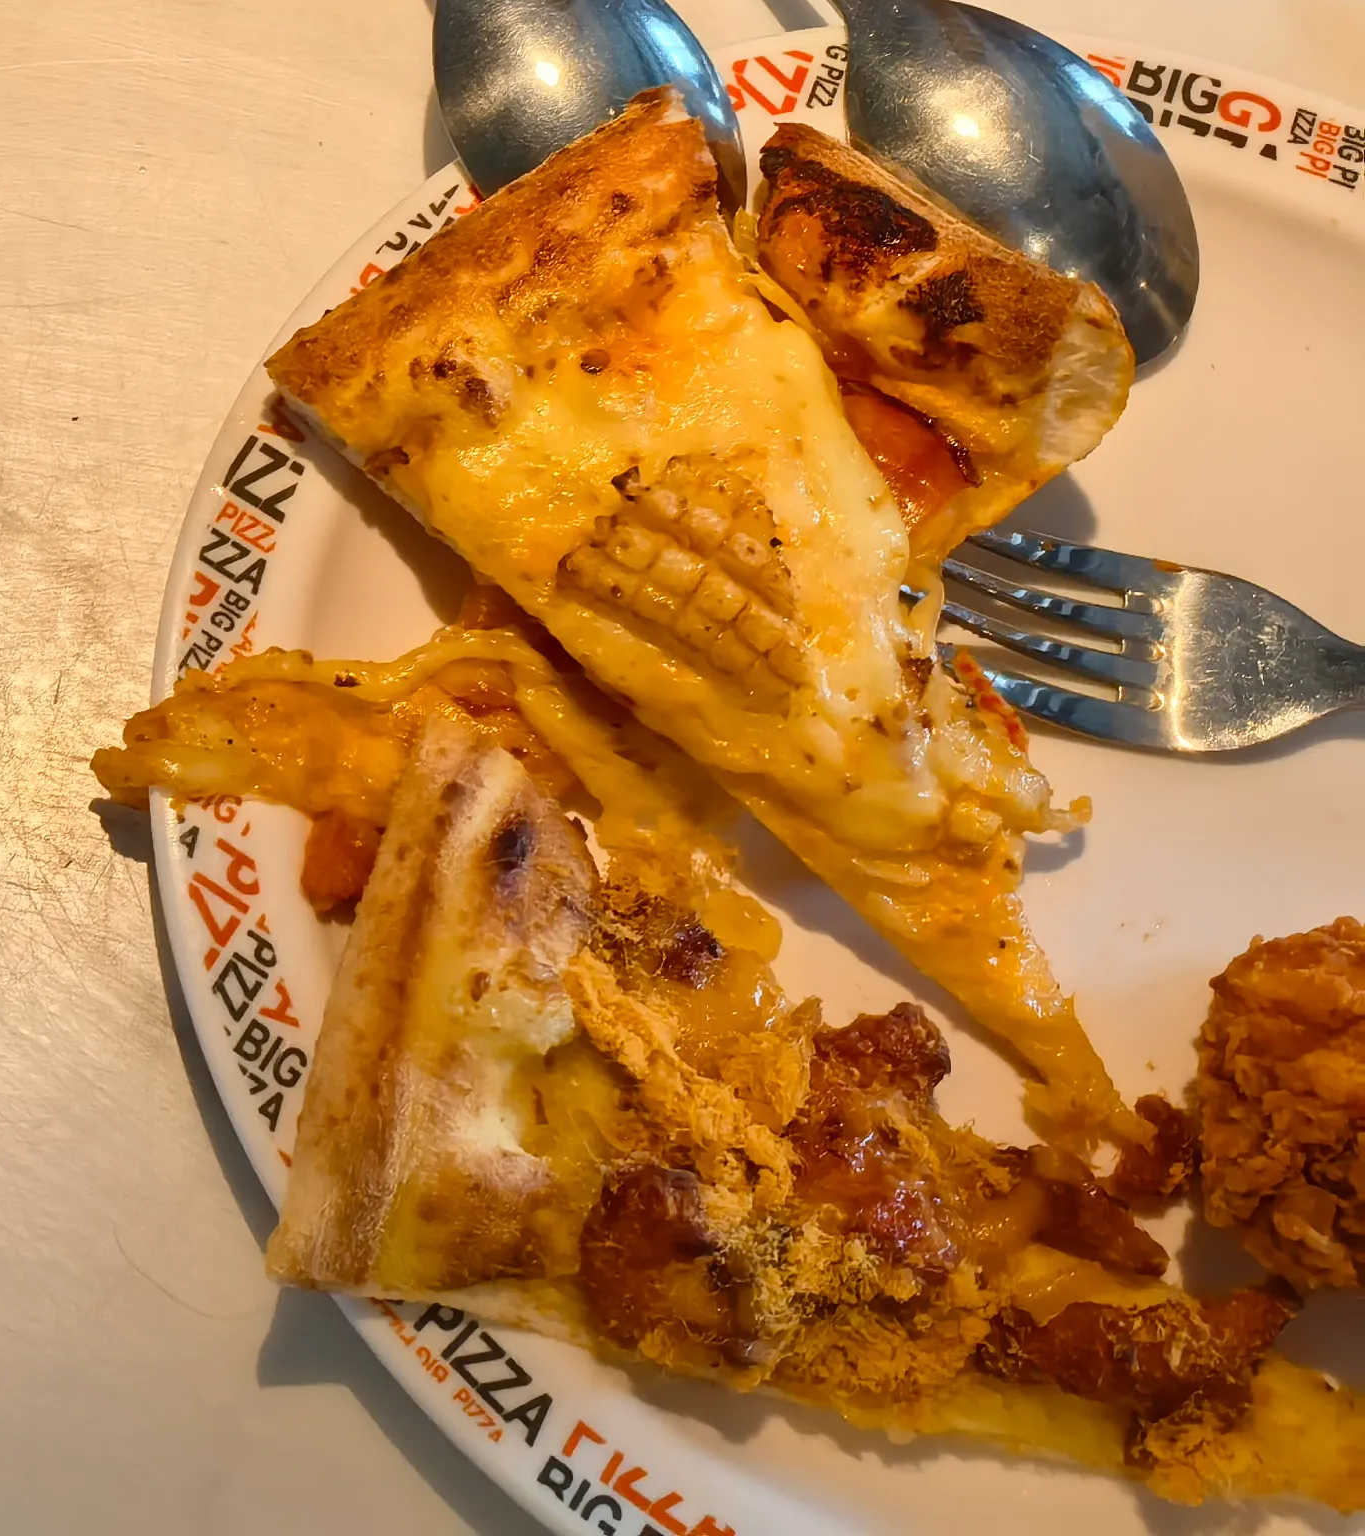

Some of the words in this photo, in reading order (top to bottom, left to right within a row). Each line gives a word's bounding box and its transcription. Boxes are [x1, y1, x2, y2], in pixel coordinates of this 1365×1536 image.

[1126, 60, 1221, 114] BIG
[1313, 120, 1342, 157] BIG
[209, 588, 251, 633] BIG
[233, 1017, 308, 1089] BIG
[413, 1302, 554, 1448] PIZZA
